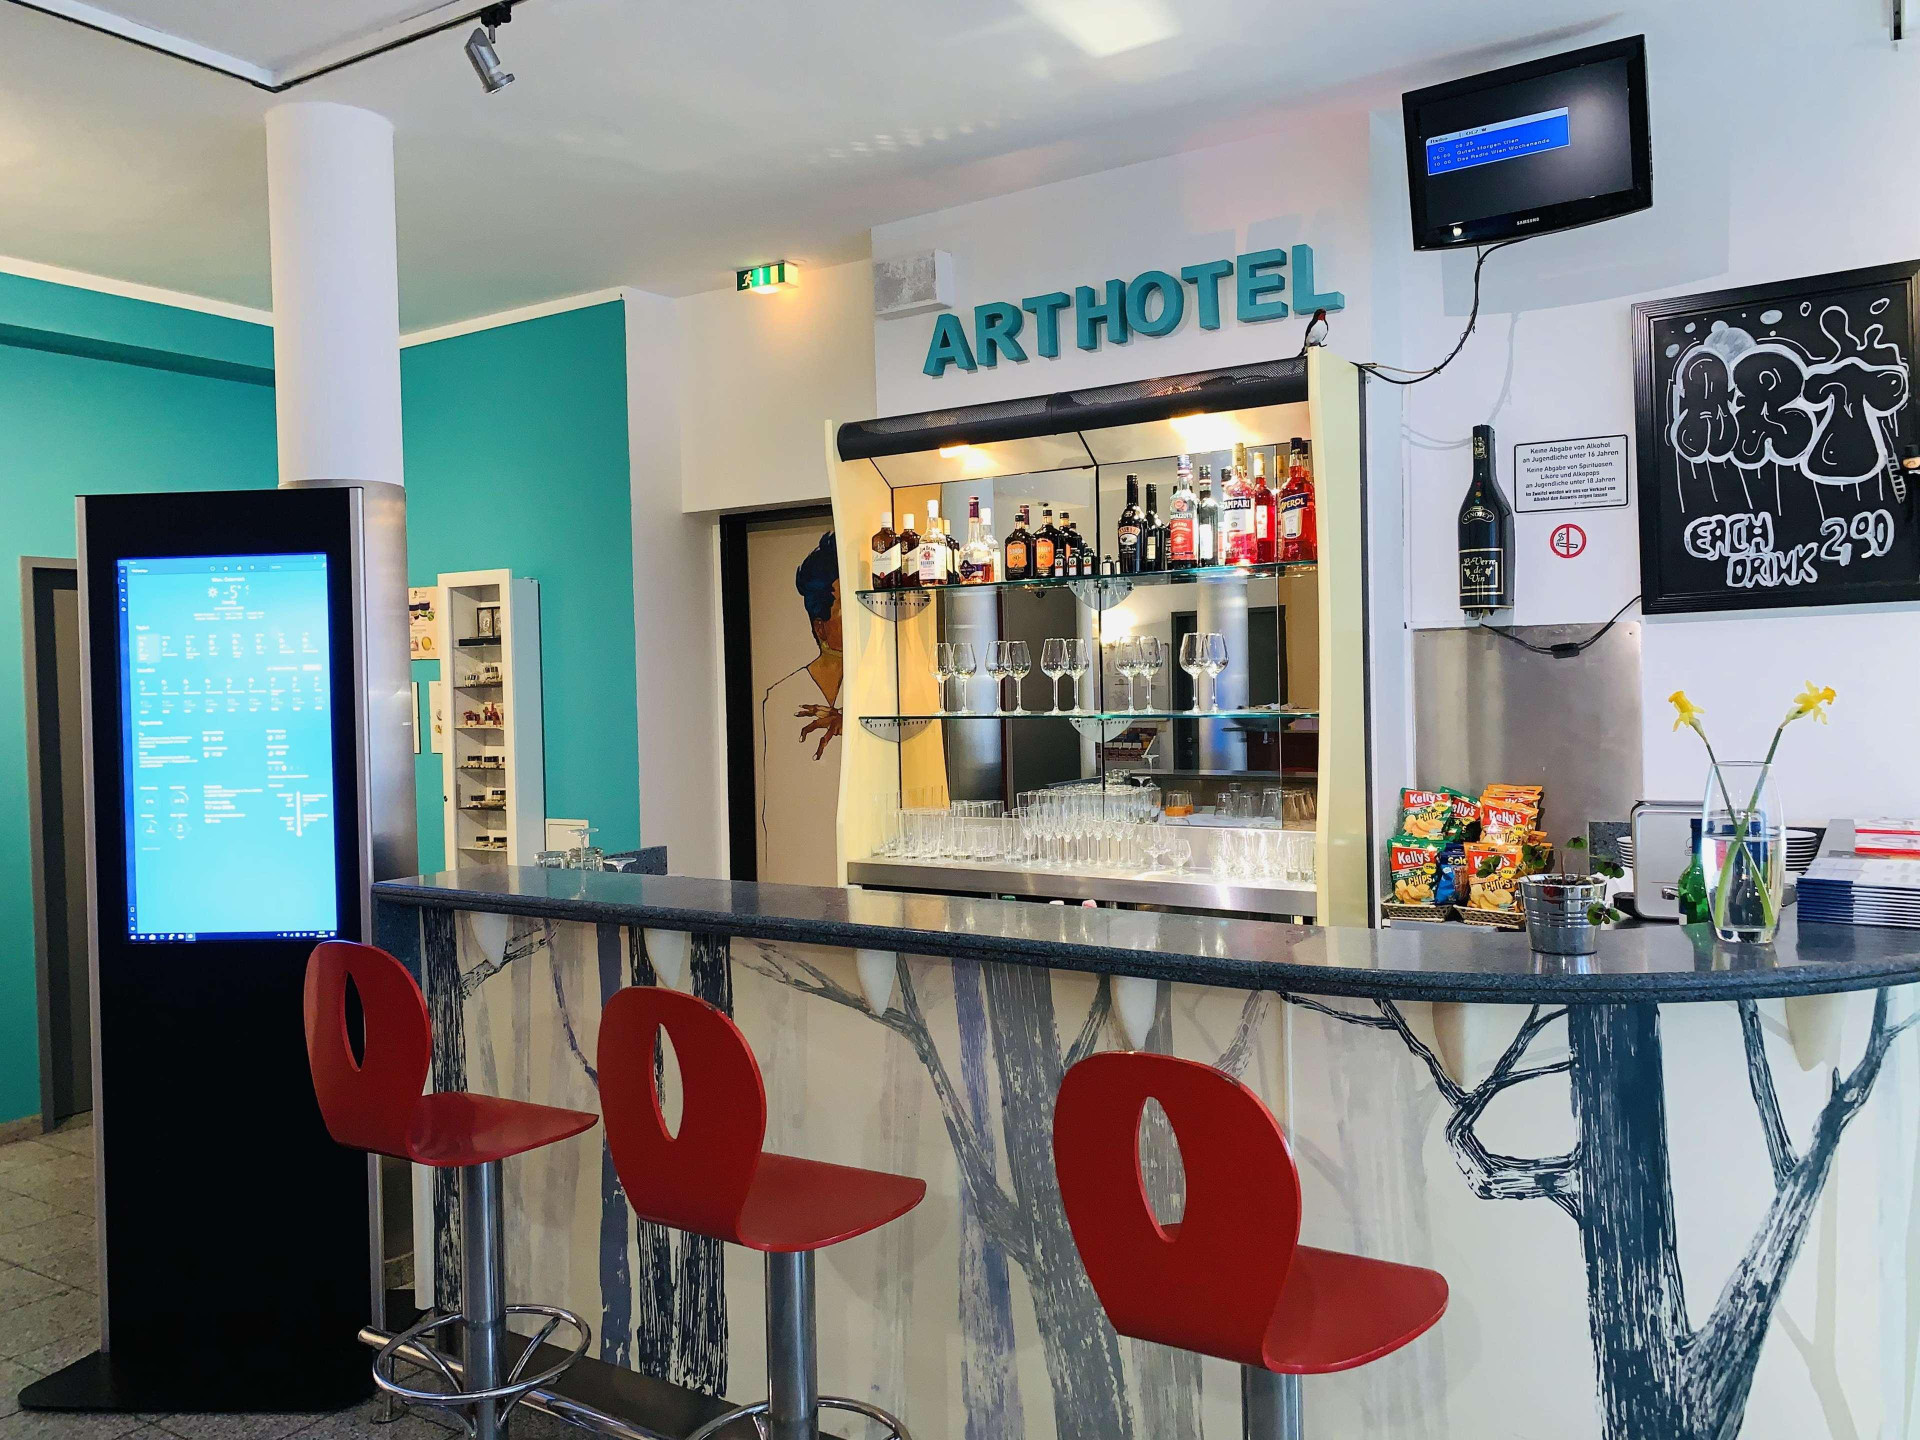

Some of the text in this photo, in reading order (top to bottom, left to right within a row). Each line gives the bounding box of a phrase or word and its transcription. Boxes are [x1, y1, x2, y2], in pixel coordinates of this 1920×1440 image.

[1471, 151, 1488, 159] Radio
[1508, 138, 1550, 151] Wochenende
[1477, 142, 1502, 153] Morgen
[922, 243, 1345, 377] ARTHOTEL
[1549, 445, 1572, 453] Abgabe
[1532, 454, 1568, 463] Jugendliche
[1534, 480, 1568, 488] Jugendliche
[1224, 499, 1250, 509] AMPARI
[1409, 793, 1443, 804] Kelly's
[1452, 801, 1476, 817] elly's
[1418, 811, 1442, 822] CHIPS
[1489, 809, 1522, 825] Kelly's
[1397, 850, 1431, 865] Kelly's
[1408, 874, 1433, 886] CHIPS
[1485, 879, 1511, 891] CHIPS
